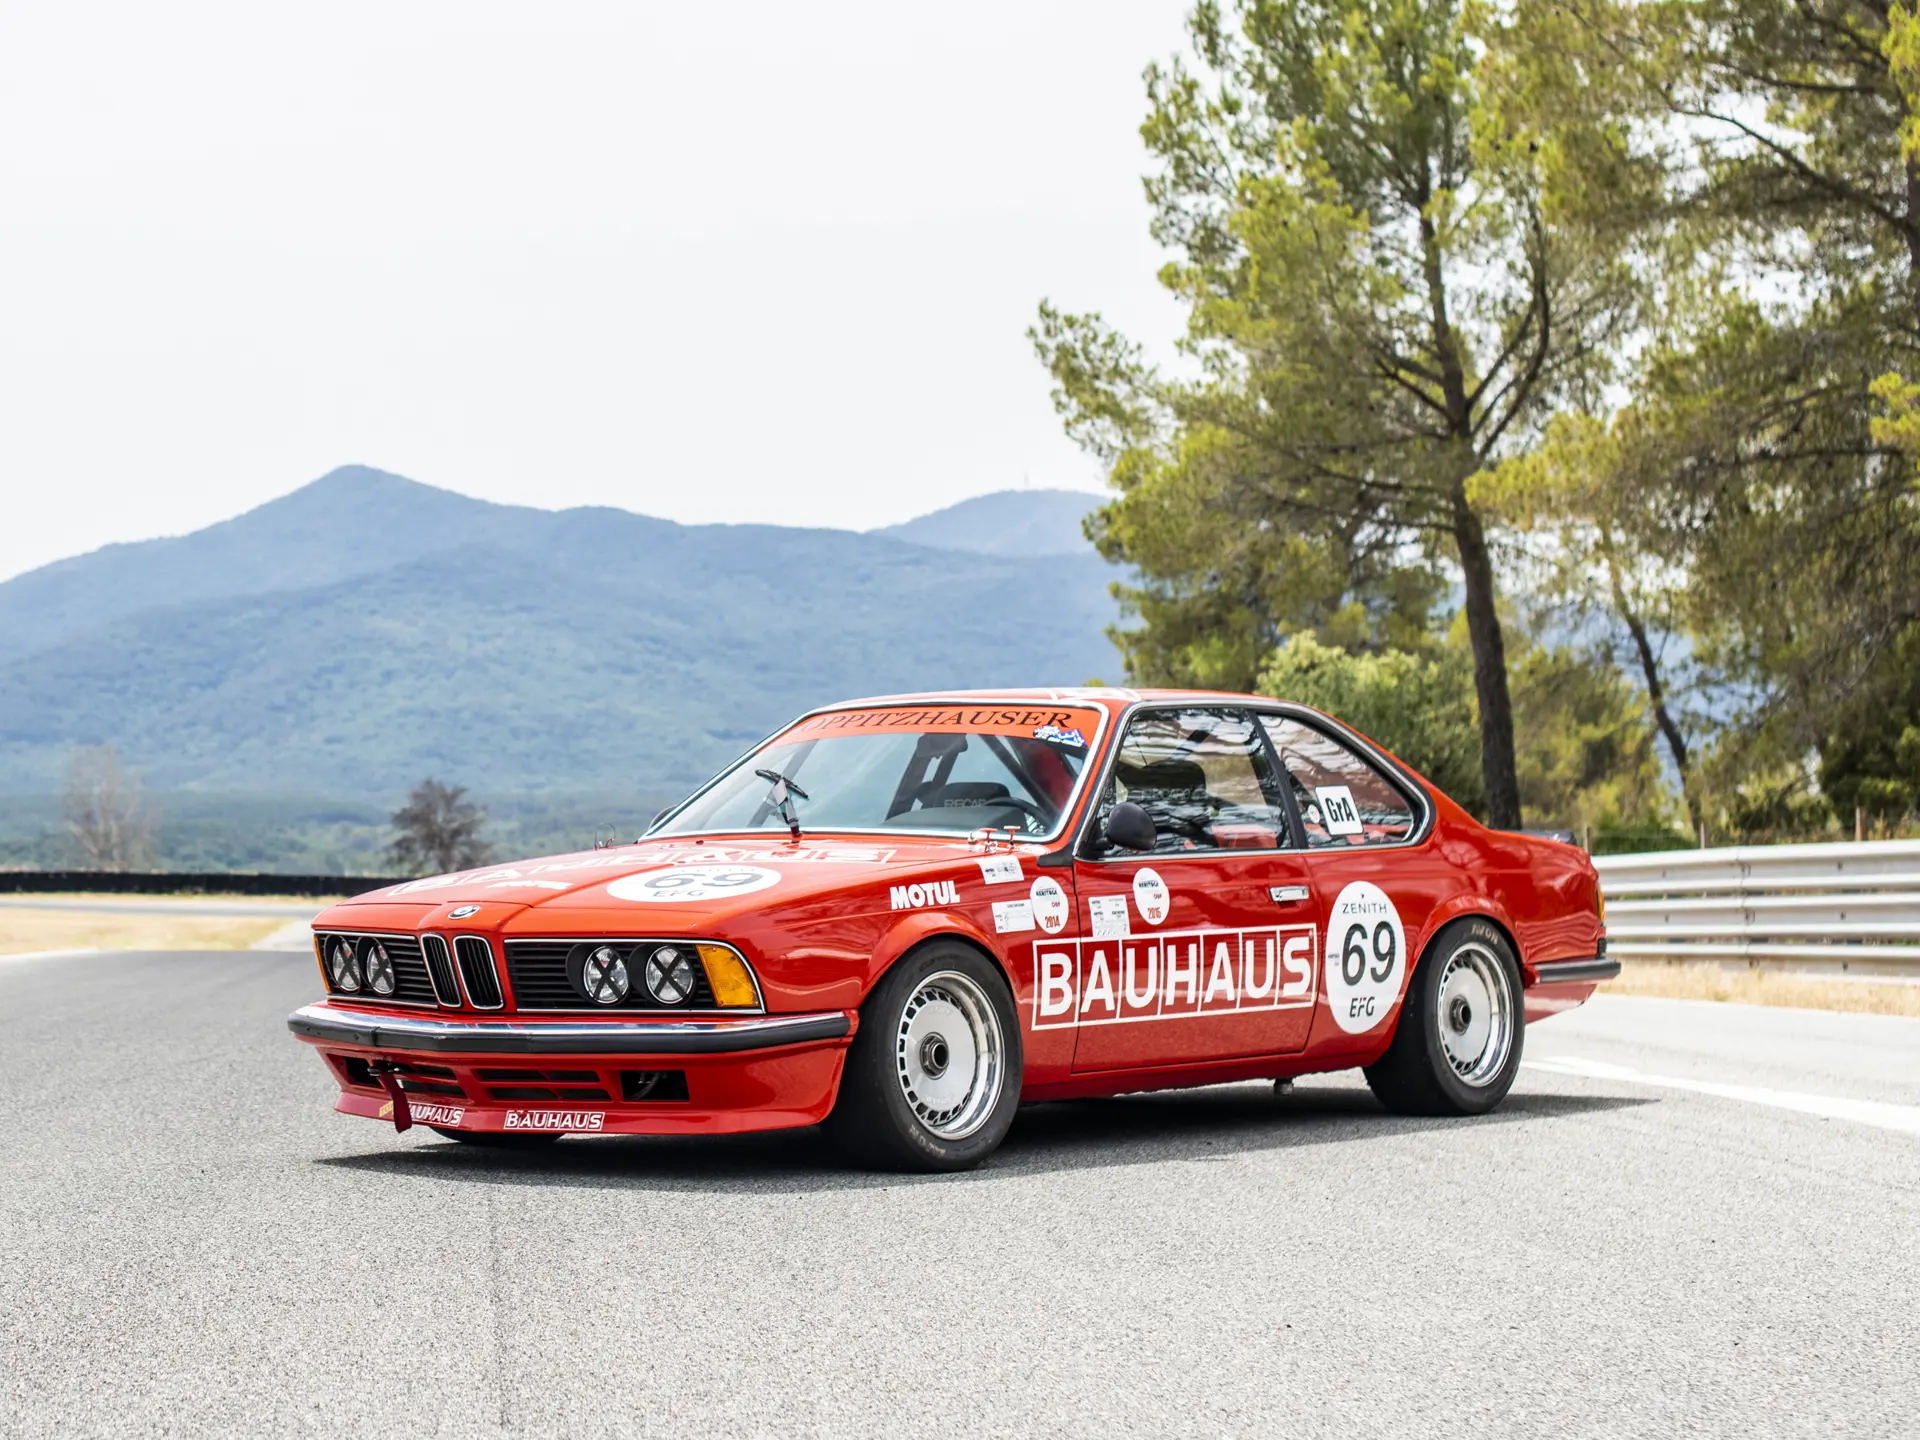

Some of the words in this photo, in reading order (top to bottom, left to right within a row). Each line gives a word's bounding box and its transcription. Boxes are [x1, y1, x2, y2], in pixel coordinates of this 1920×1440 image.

[944, 798, 988, 808] RECAR
[1325, 797, 1355, 823] GrA
[644, 872, 763, 889] 69
[889, 880, 961, 910] MOTUL
[1342, 903, 1388, 914] ZENITH
[1342, 920, 1396, 986] 69
[1040, 936, 1311, 1017] BAUHAUS
[1349, 996, 1375, 1018] EFG
[409, 1104, 462, 1124] AUHAUS
[506, 1113, 602, 1129] BAUHAUS
